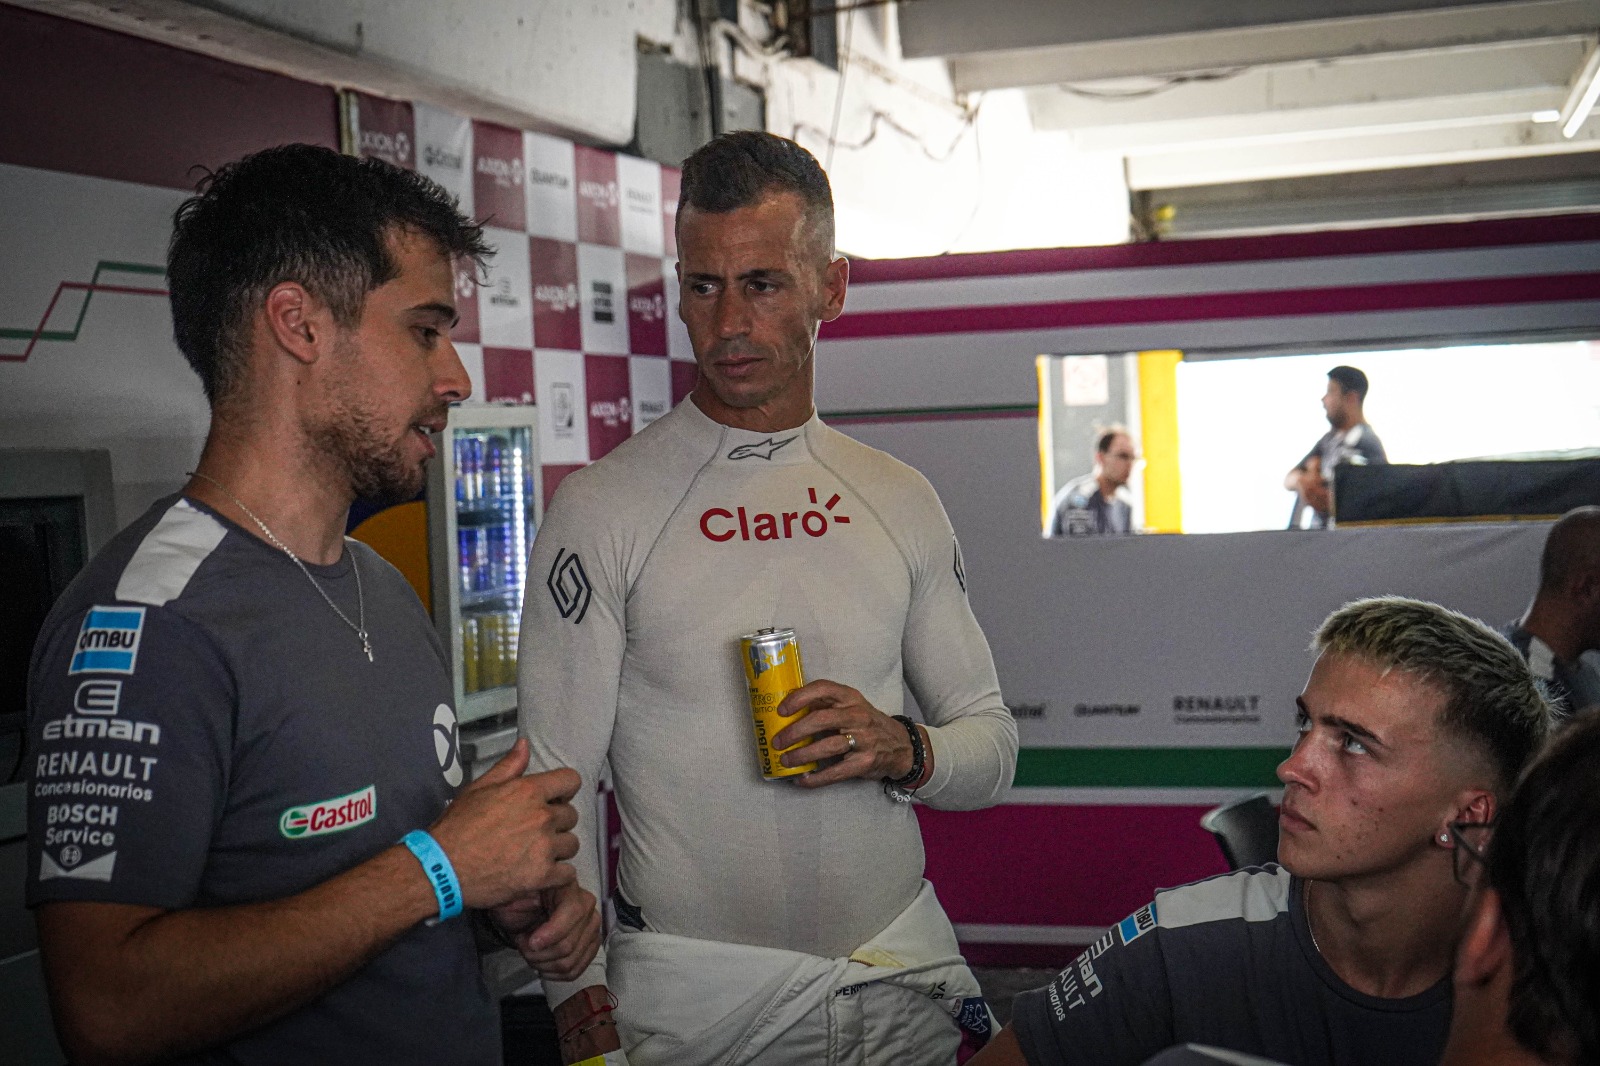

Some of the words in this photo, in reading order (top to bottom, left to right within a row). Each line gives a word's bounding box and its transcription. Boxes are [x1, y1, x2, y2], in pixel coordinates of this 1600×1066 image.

[699, 505, 828, 543] Claro
[755, 719, 768, 746] Bull
[36, 750, 158, 782] RENAULT
[760, 748, 772, 775] Red
[35, 778, 153, 803] Concesionarios
[47, 803, 119, 826] BOSCH
[310, 791, 373, 832] Castrol
[45, 825, 116, 847] Service
